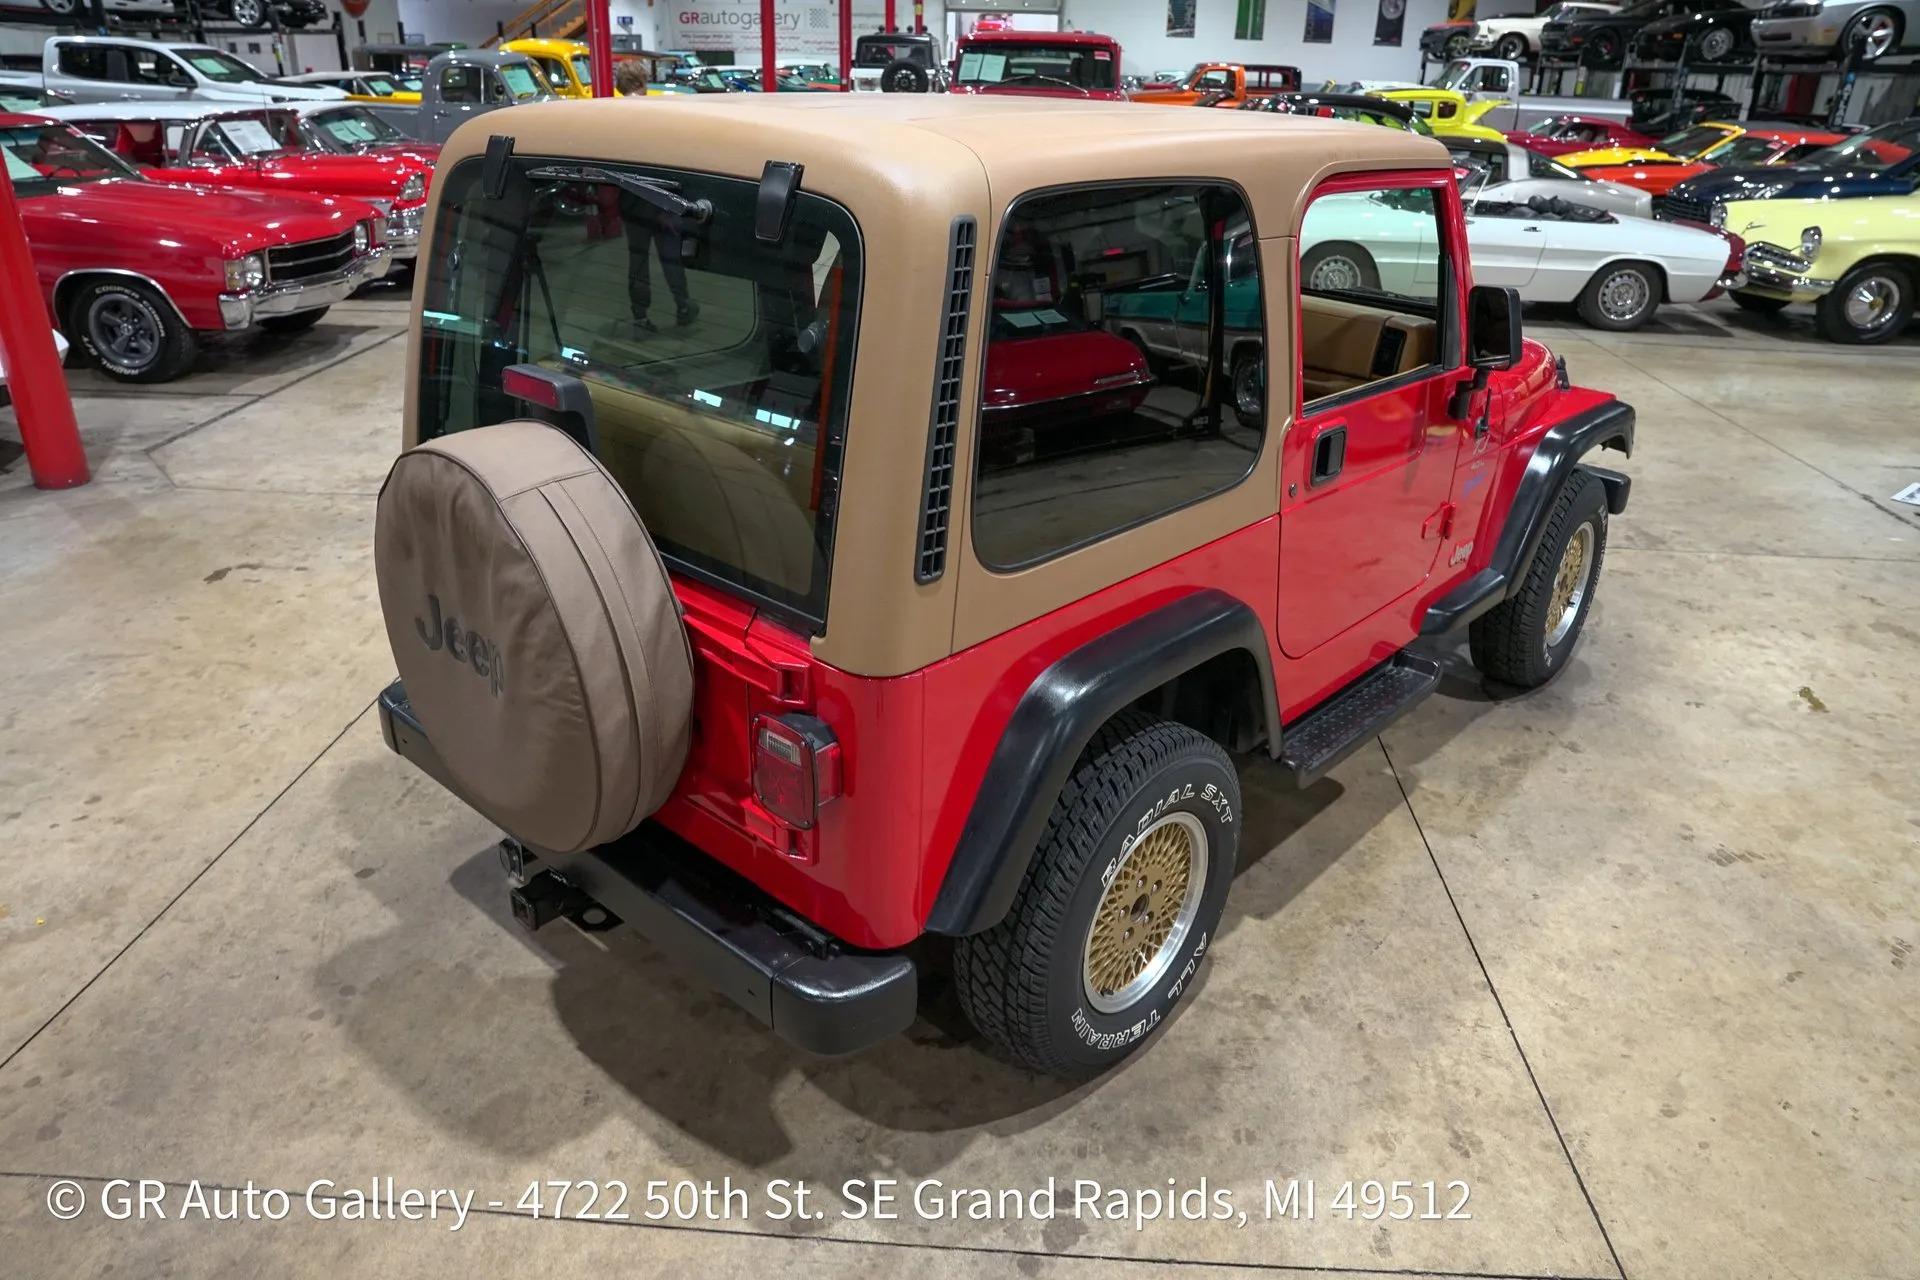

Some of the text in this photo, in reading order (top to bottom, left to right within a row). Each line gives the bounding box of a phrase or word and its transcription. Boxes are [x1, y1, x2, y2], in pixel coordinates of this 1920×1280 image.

[679, 10, 800, 31] GRautogaery
[101, 358, 139, 375] RADIAL
[414, 593, 505, 699] Jeep
[1101, 783, 1233, 888] RADIAL SXT
[1071, 931, 1207, 1050] ALL TERRAIN
